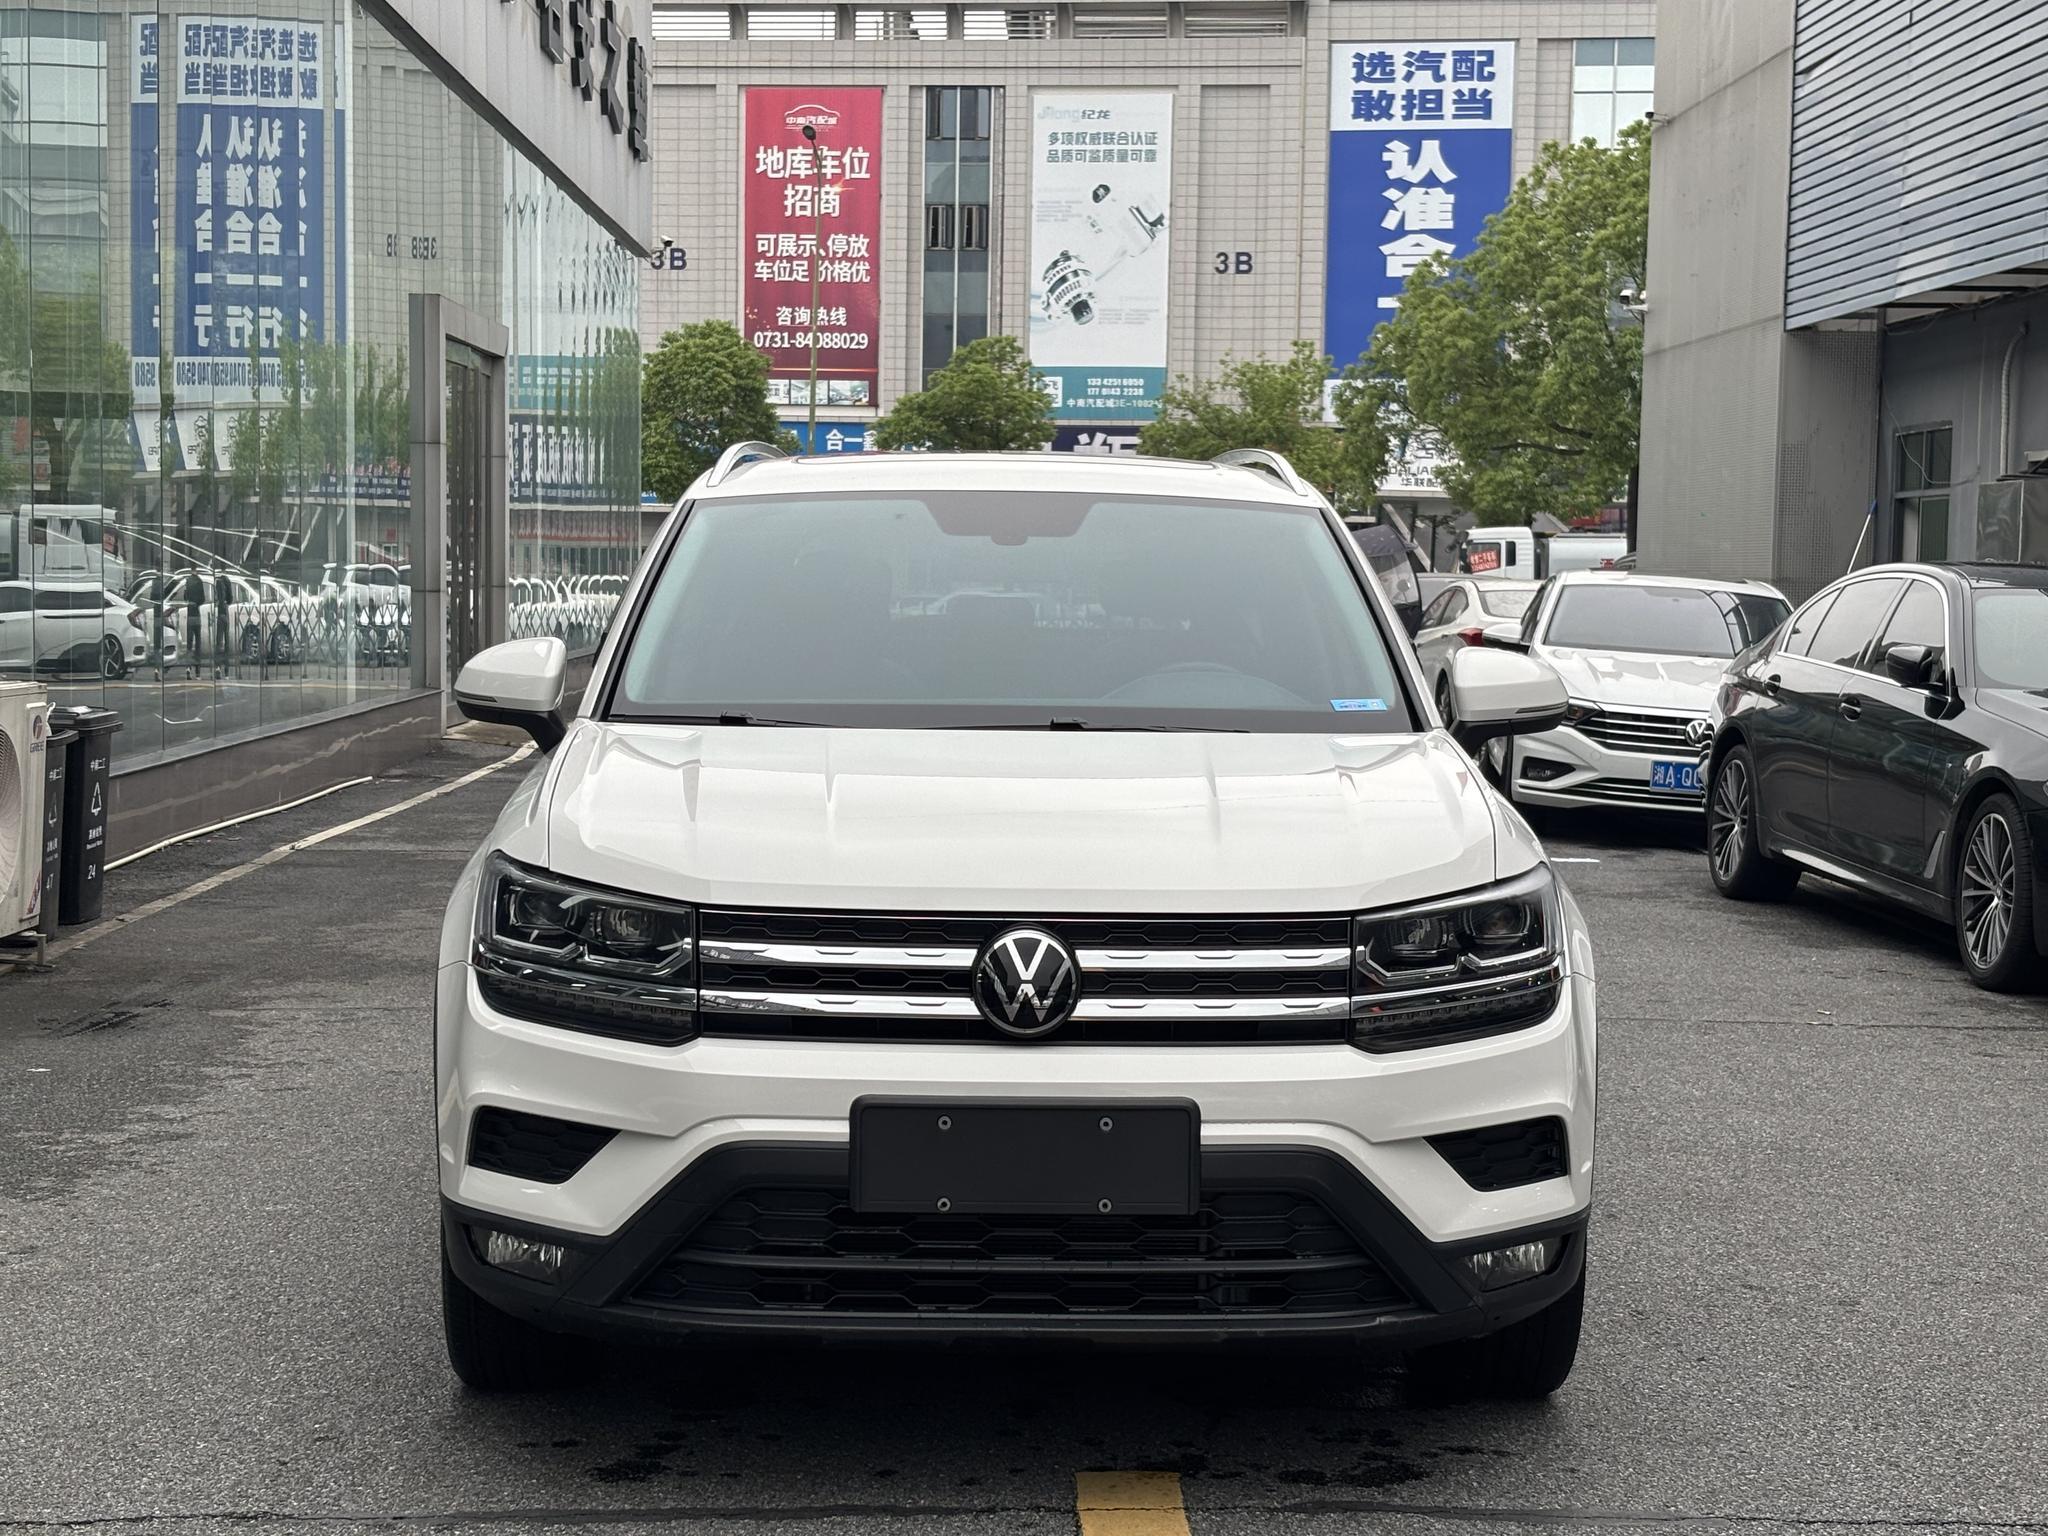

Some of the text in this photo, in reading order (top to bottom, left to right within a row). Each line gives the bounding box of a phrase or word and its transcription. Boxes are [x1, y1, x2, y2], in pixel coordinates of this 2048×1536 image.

[1351, 49, 1496, 83] 选汽配
[1351, 88, 1492, 122] 敢担当
[1048, 131, 1158, 146] 多项权威联合认证
[755, 145, 870, 179] 地库车位
[784, 184, 840, 217] 招商
[1215, 251, 1253, 275] 3B
[776, 306, 847, 326] 咨询热线
